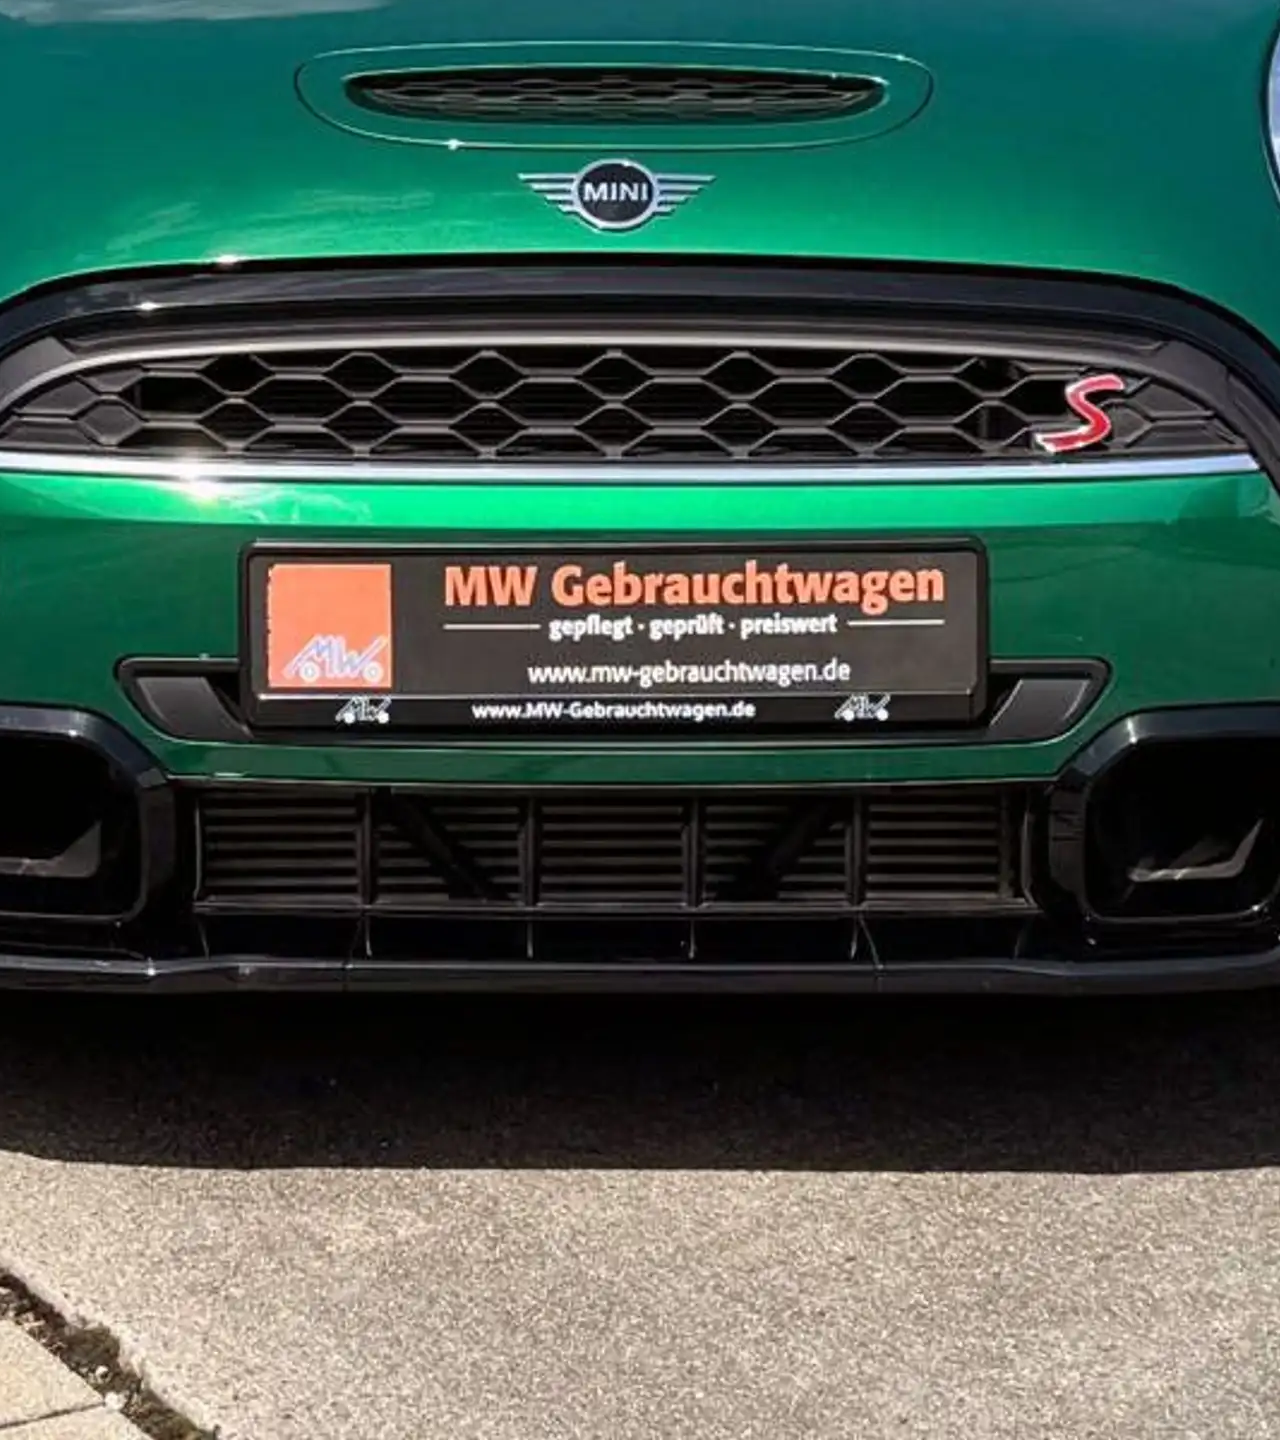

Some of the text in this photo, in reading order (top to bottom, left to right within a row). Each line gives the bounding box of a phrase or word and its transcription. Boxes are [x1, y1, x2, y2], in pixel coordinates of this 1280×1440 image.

[582, 182, 650, 202] MINI
[1033, 373, 1125, 453] S
[444, 559, 946, 615] MW Gebrauchtwagen
[548, 613, 839, 641] gepflegt geprüft preiswert
[527, 657, 852, 687] www.mw-gebrauchtwagen.de
[472, 701, 757, 722] www.MW-Gebrauchtwagen.de
